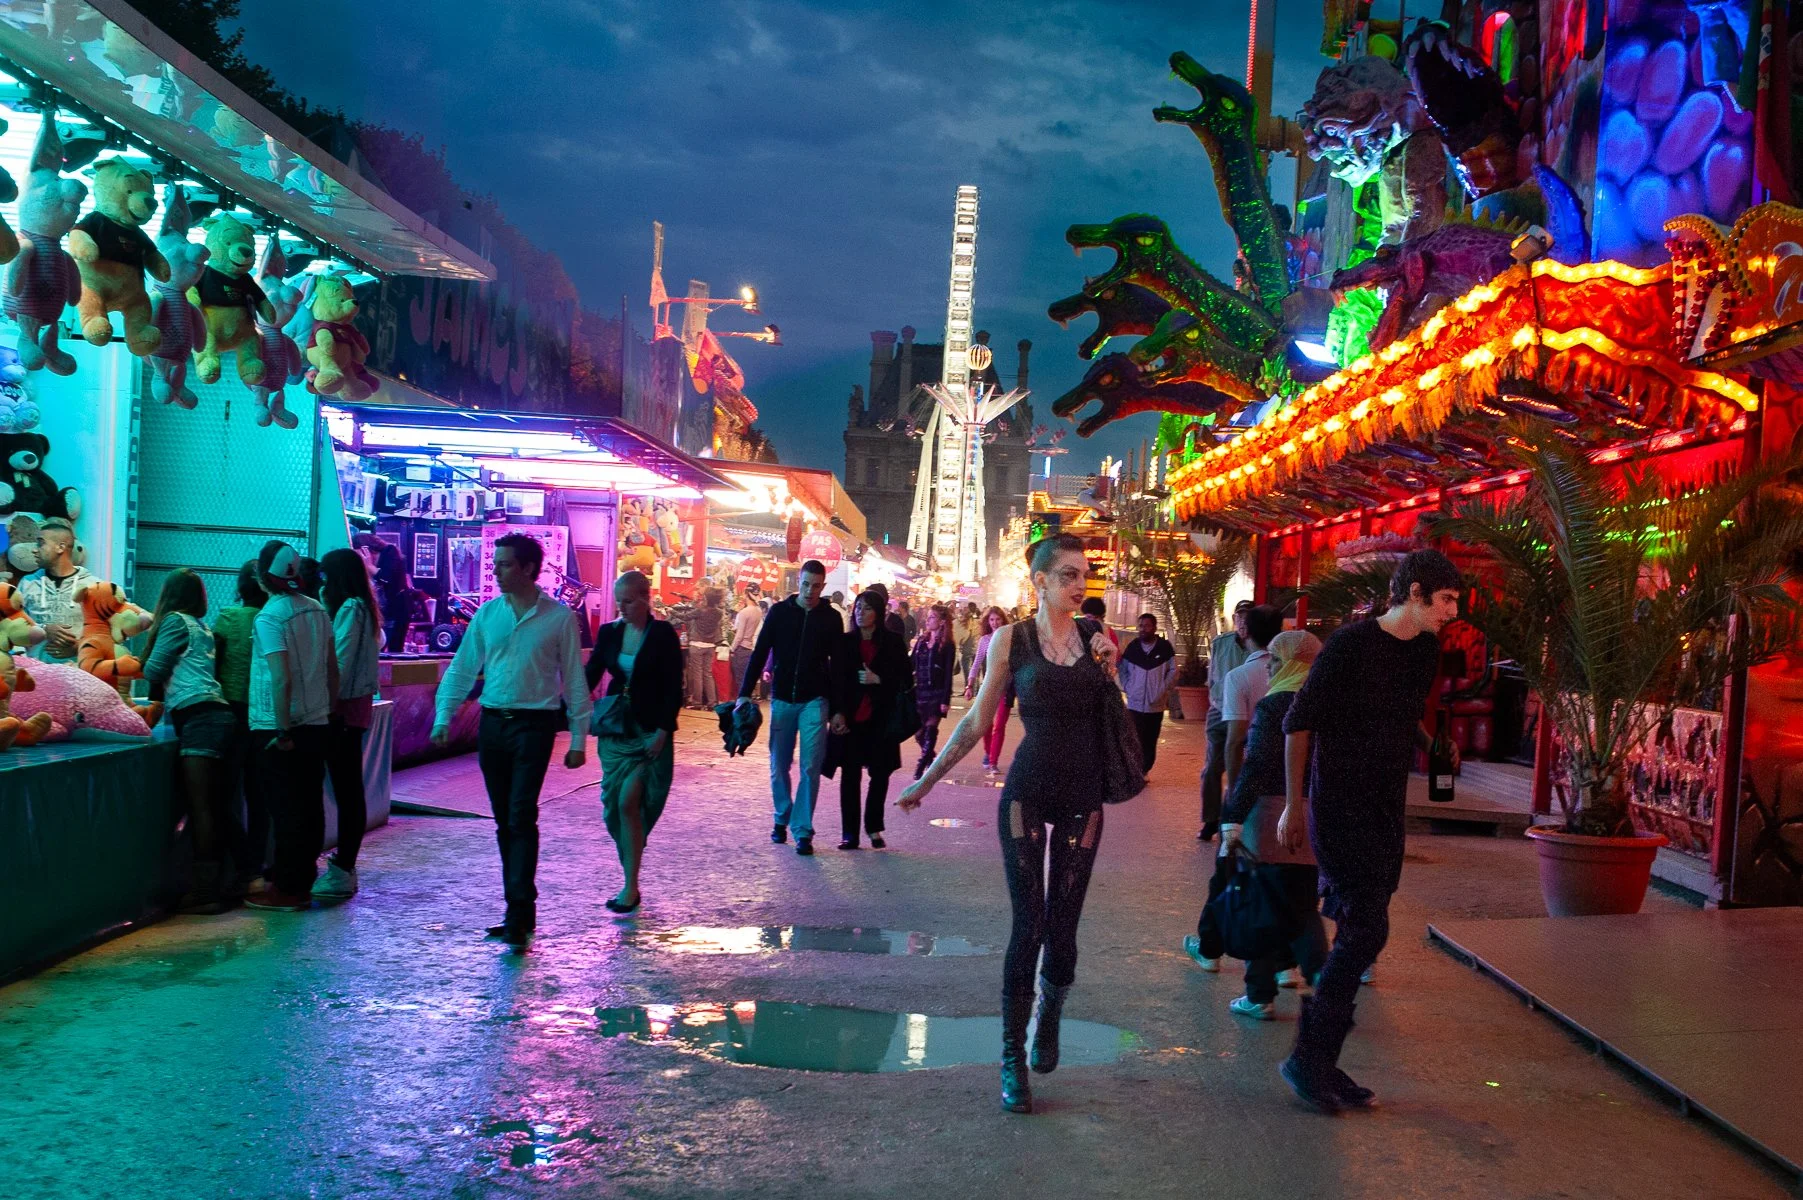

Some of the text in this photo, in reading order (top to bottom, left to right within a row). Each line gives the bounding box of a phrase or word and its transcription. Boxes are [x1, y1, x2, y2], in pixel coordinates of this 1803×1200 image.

[557, 532, 562, 540] 6
[811, 535, 832, 547] PAS
[815, 548, 827, 556] DE
[484, 563, 494, 571] 30
[484, 574, 493, 582] 10
[555, 576, 560, 584] 9
[483, 585, 493, 593] 29
